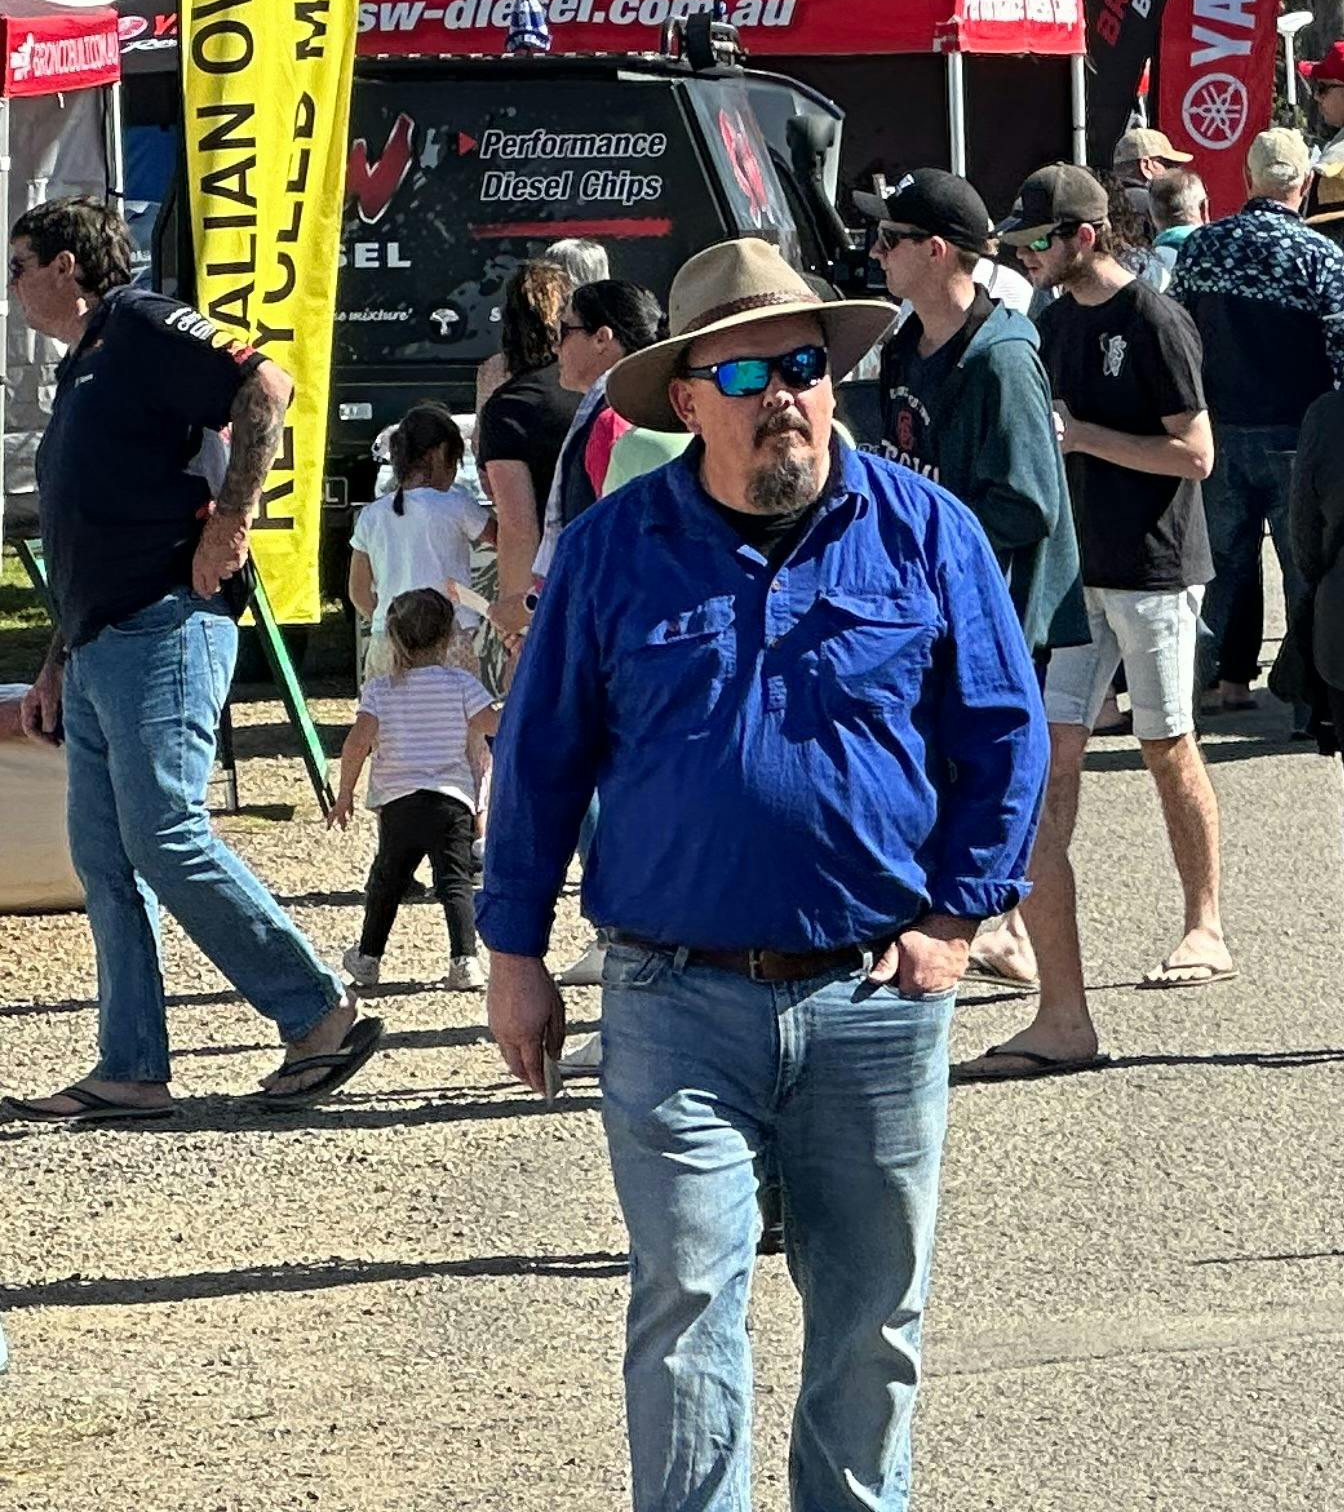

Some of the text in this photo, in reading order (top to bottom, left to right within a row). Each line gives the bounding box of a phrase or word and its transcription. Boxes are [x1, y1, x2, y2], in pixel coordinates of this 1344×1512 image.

[480, 128, 667, 159] Performance
[480, 170, 663, 206] Diesel Chips
